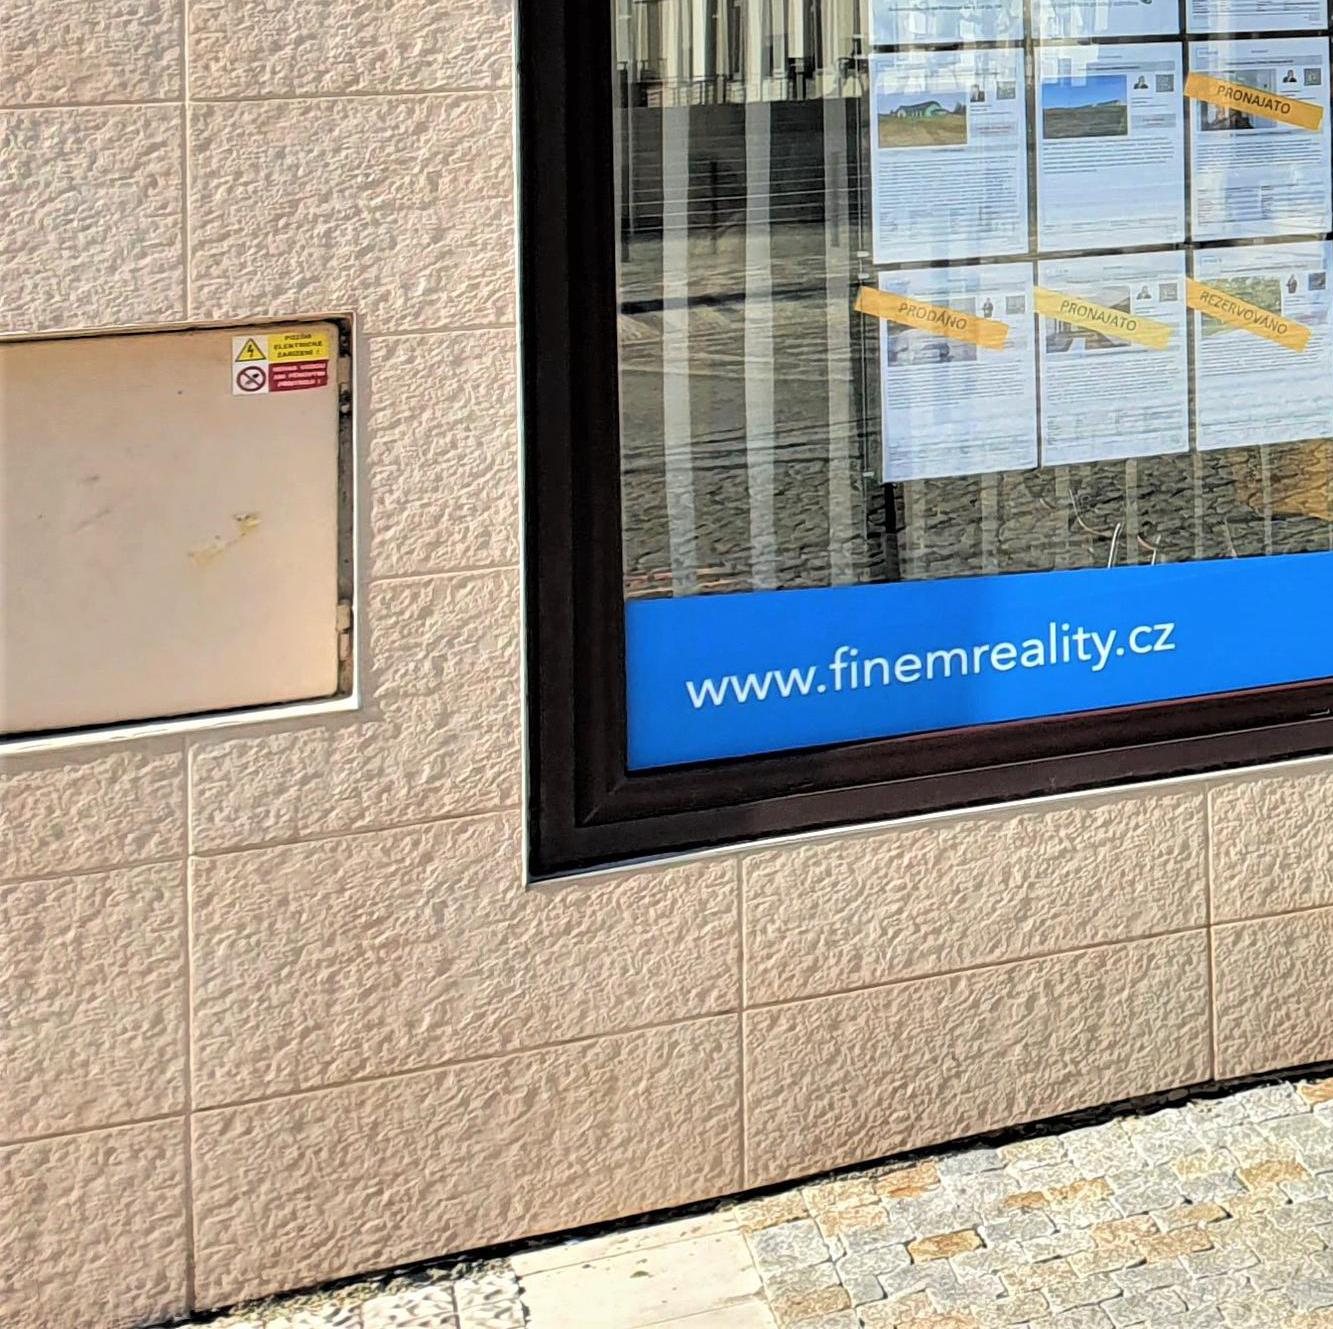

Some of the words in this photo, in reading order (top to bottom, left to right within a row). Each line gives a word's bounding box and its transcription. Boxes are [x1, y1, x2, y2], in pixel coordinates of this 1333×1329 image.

[1217, 84, 1291, 114] PRONAJATO
[1059, 299, 1138, 332] PRONAJATO
[685, 621, 1177, 710] www.finemreality.cz
